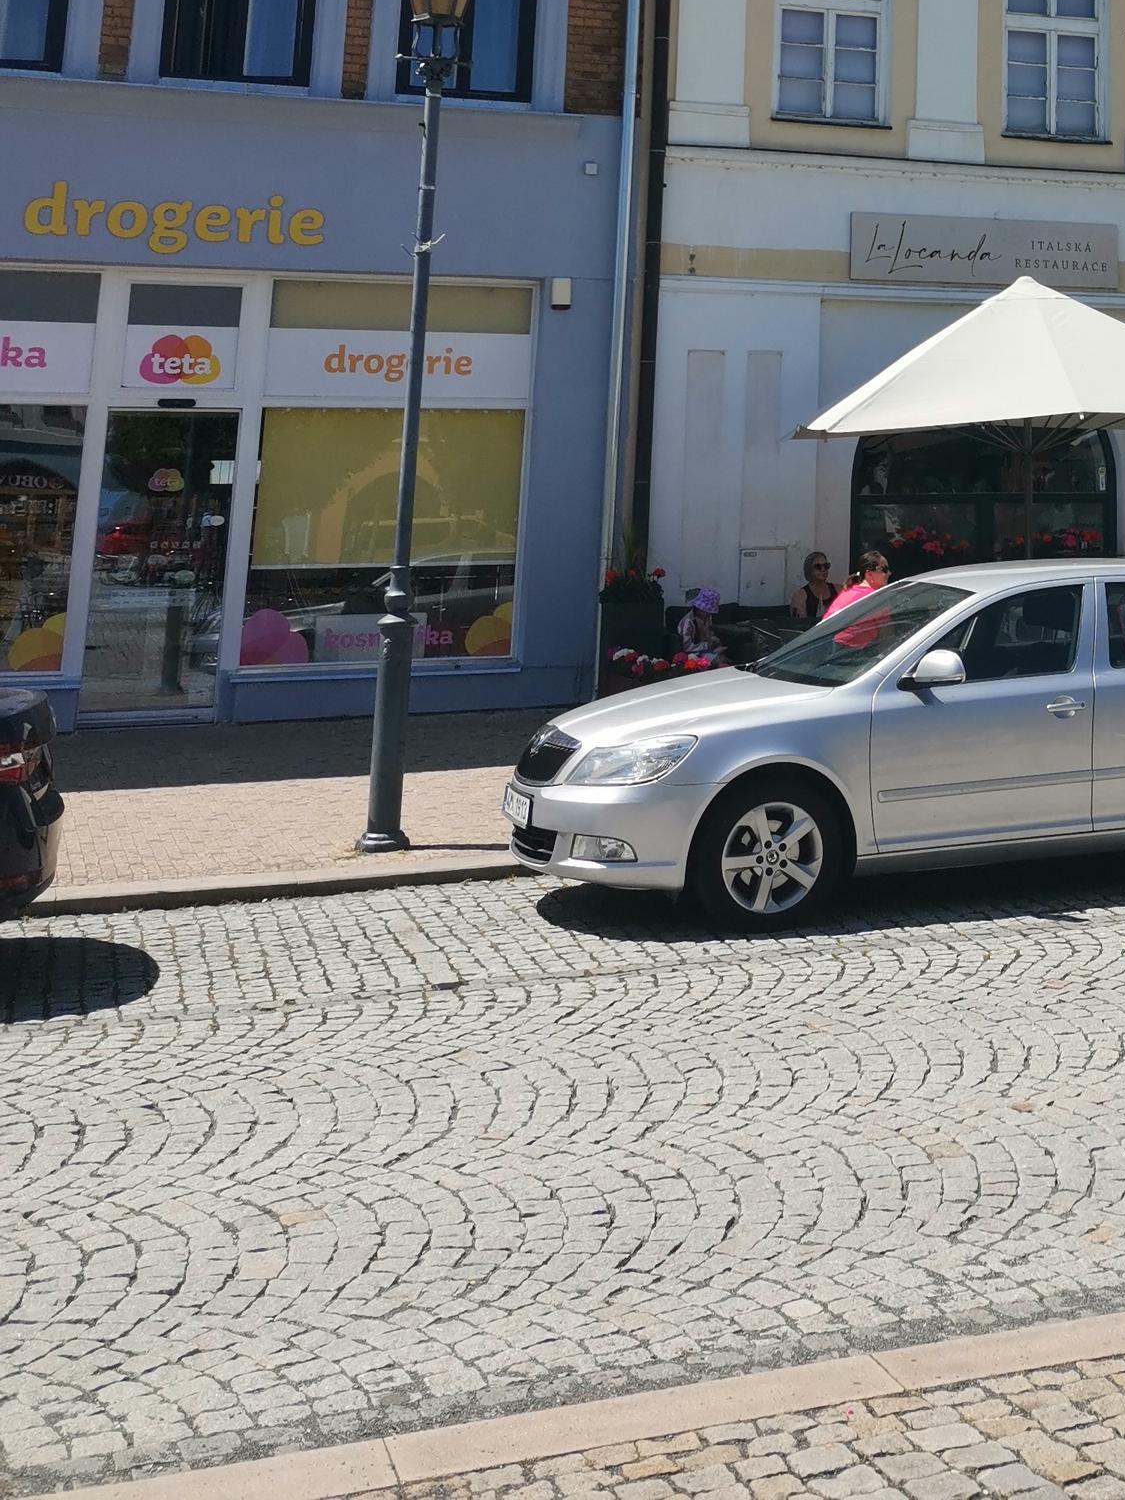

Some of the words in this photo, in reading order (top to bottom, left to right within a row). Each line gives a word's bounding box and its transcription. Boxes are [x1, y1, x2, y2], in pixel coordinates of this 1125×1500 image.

[23, 180, 326, 255] drogerie
[865, 222, 893, 263] La
[888, 220, 1003, 277] Locanda
[1030, 239, 1092, 254] ITALSKÁ
[1014, 257, 1109, 273] RESTAURACE
[151, 352, 213, 376] teta
[323, 344, 474, 383] drogrie
